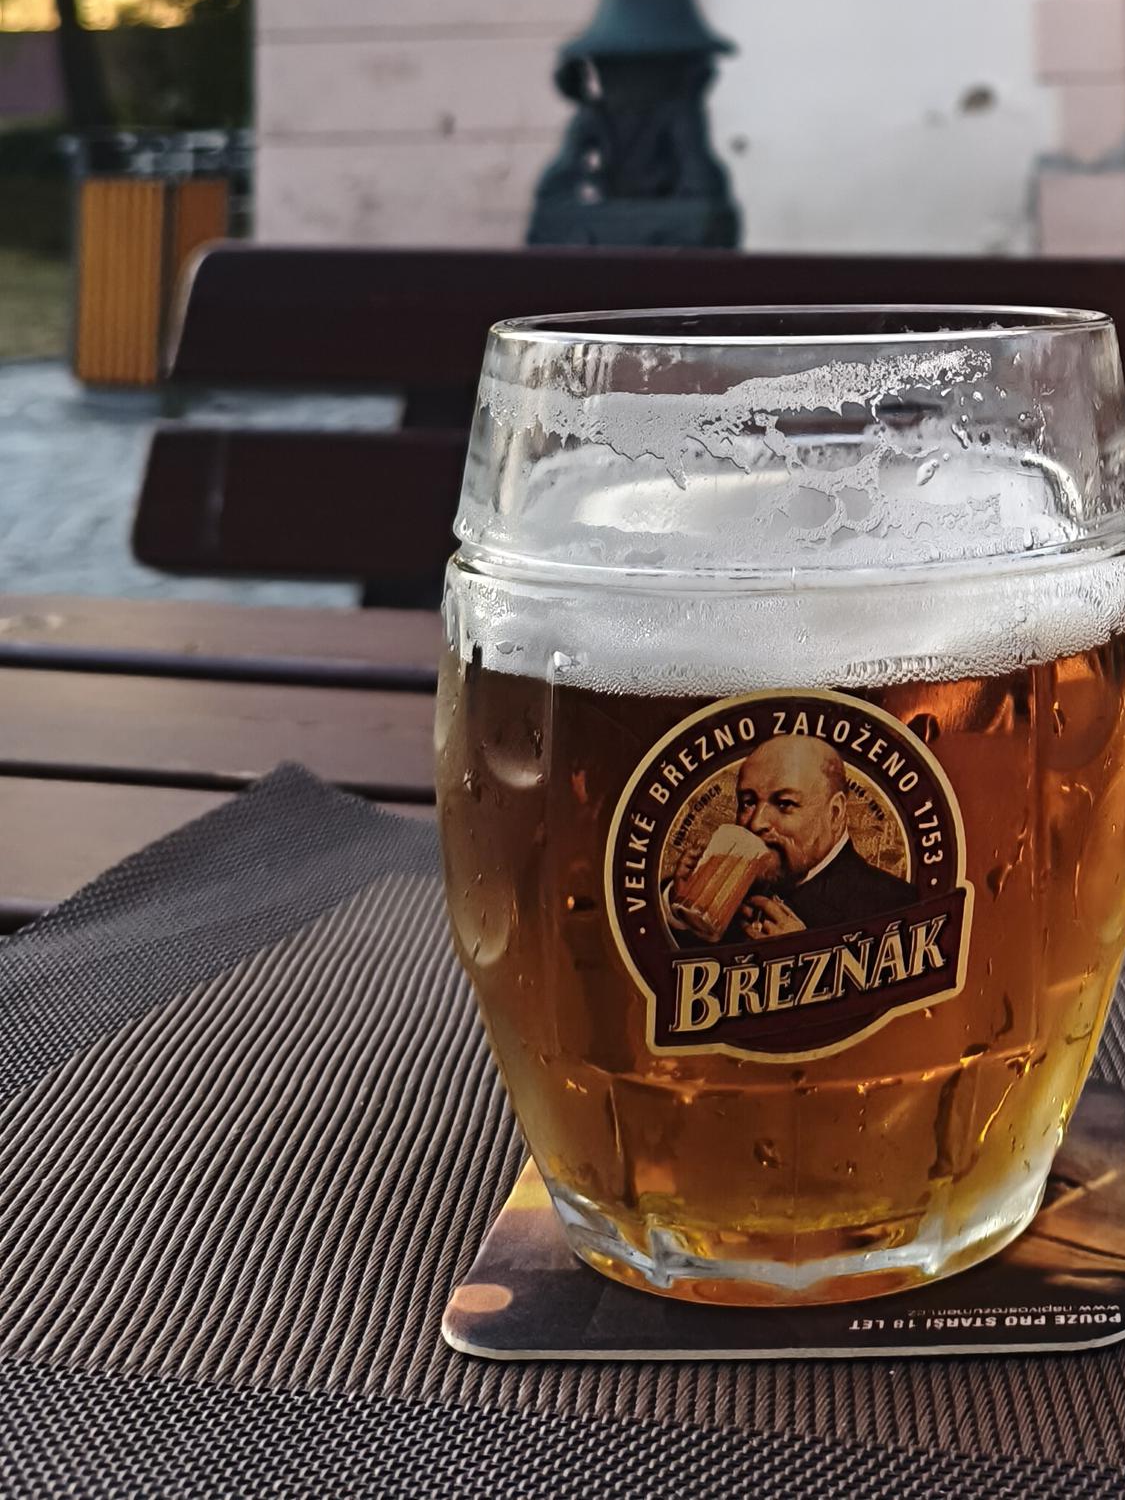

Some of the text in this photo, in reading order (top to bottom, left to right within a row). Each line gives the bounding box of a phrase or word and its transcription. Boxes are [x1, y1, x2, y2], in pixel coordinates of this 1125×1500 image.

[625, 809, 657, 912] VELKÉ
[648, 716, 756, 805] BŘEZNO
[772, 710, 920, 792] ZALOŽENO
[914, 800, 944, 865] 1753
[669, 913, 949, 1034] BŘEZŇÁK
[849, 1319, 886, 1331] LET
[926, 1316, 997, 1331] STARŠÍ
[1005, 1314, 1047, 1327] PRO
[1055, 1312, 1122, 1325] POUZE
